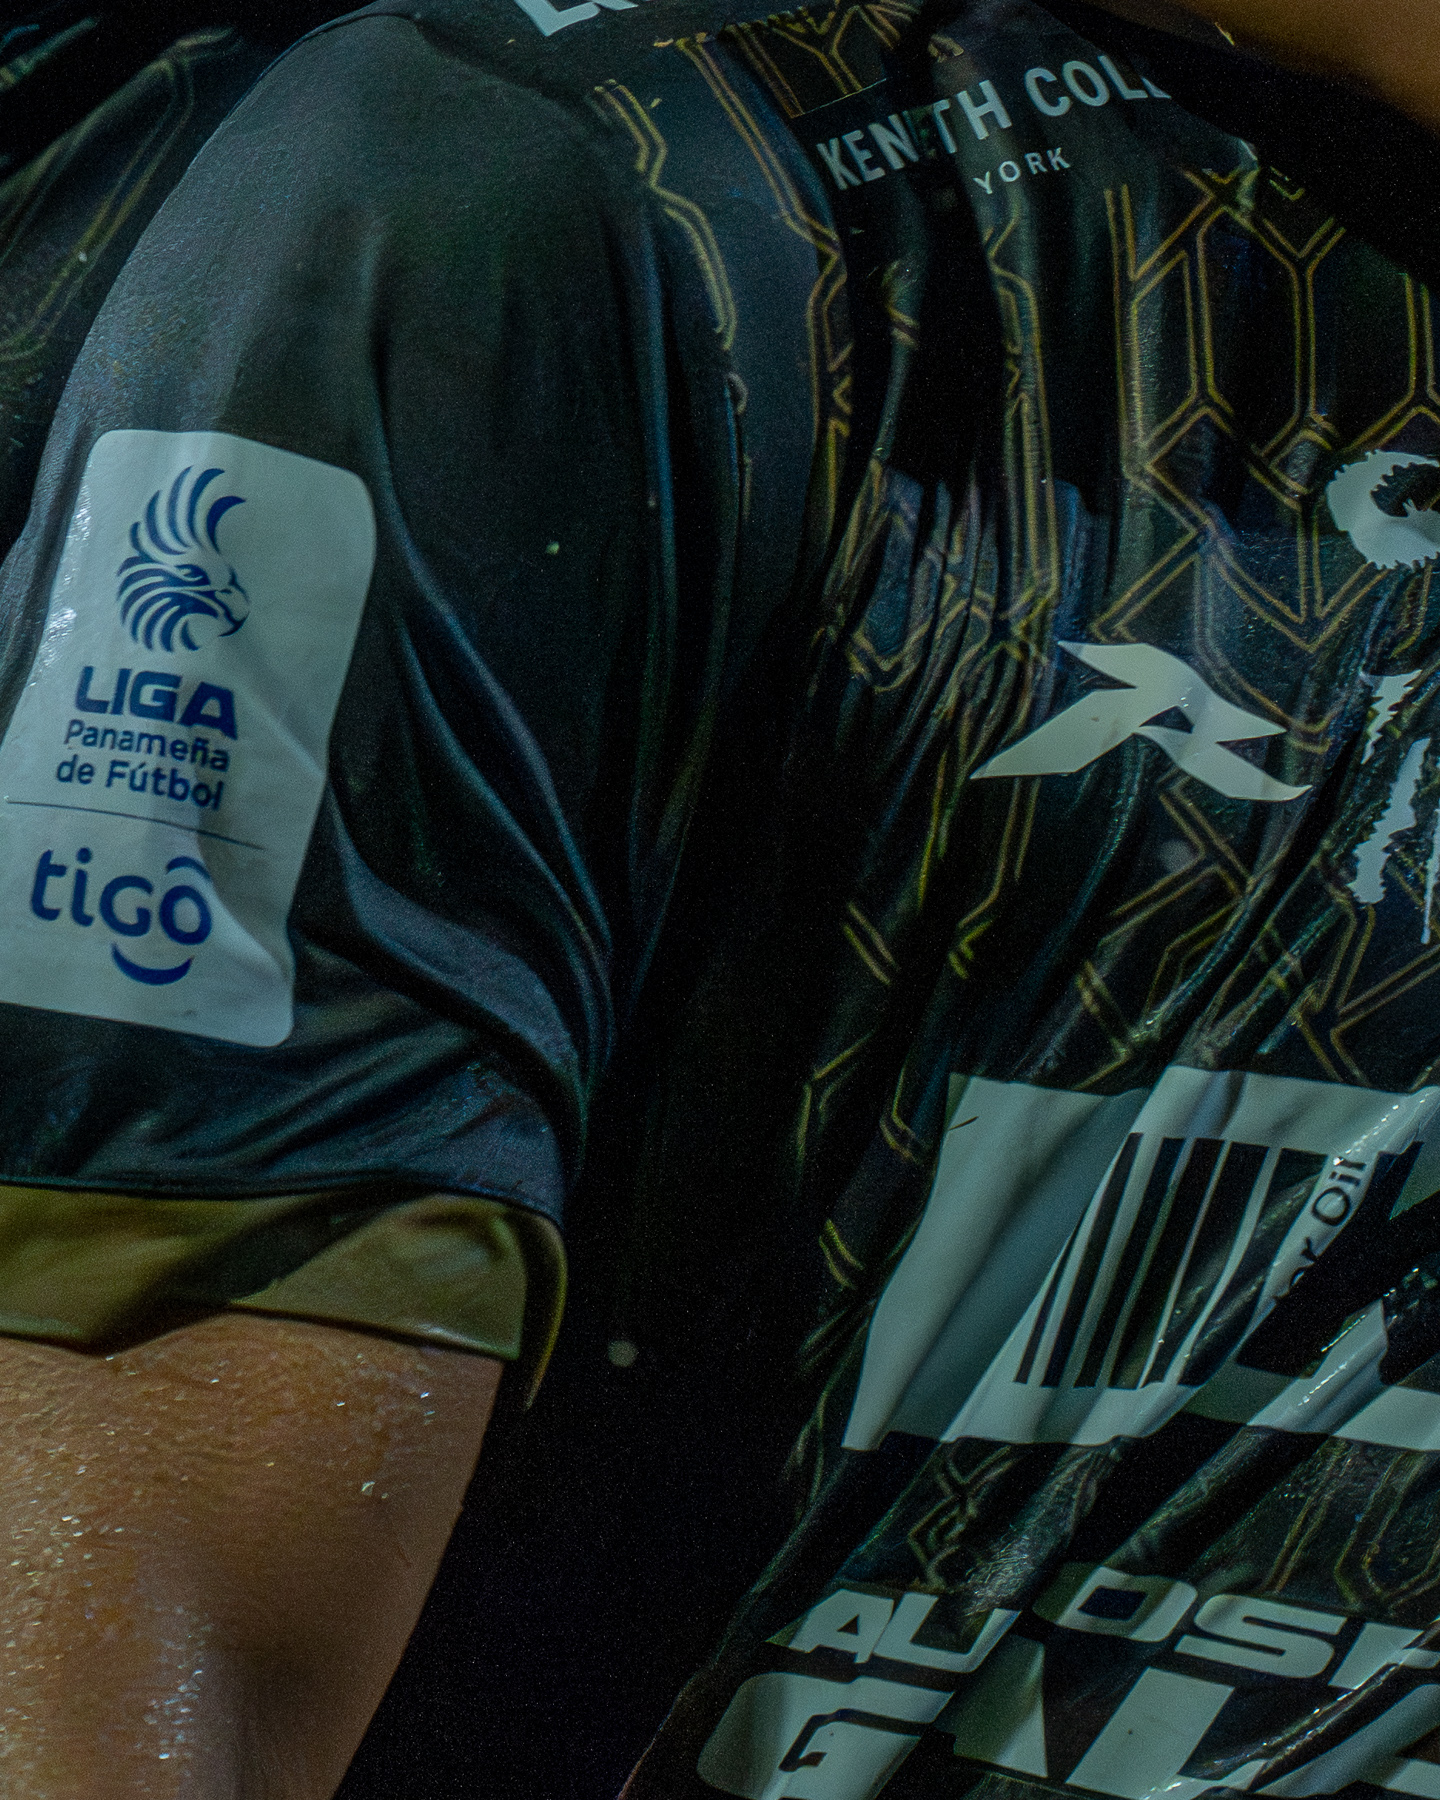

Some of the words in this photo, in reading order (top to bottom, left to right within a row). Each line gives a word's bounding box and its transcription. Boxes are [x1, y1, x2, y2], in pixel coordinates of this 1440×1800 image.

[1024, 55, 1172, 116] COL
[973, 147, 1070, 195] YORK
[75, 666, 238, 741] LIGA
[64, 719, 230, 773] Panameña
[56, 753, 96, 785] de
[106, 759, 225, 811] Fútbol
[1311, 1155, 1367, 1227] Oil
